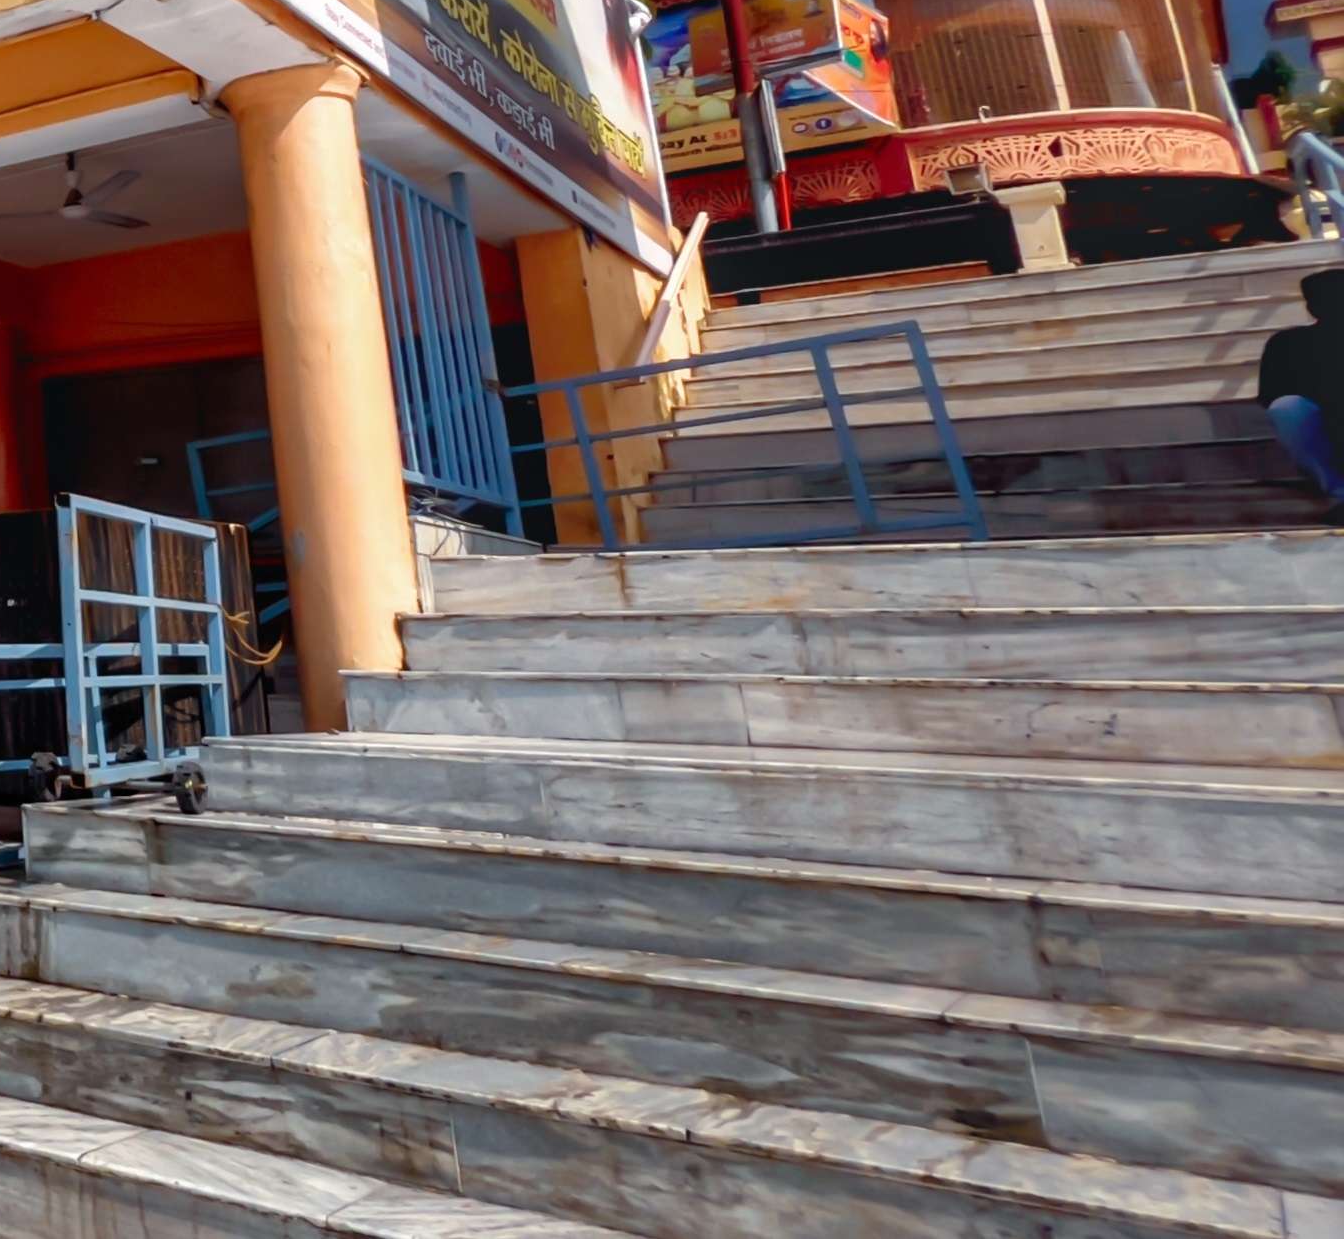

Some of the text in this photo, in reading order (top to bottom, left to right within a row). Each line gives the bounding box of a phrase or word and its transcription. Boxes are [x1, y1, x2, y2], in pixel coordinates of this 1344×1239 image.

[423, 28, 467, 85] दवाई
[538, 116, 555, 151] भी
[500, 27, 560, 107] कोरोना
[560, 81, 578, 122] से
